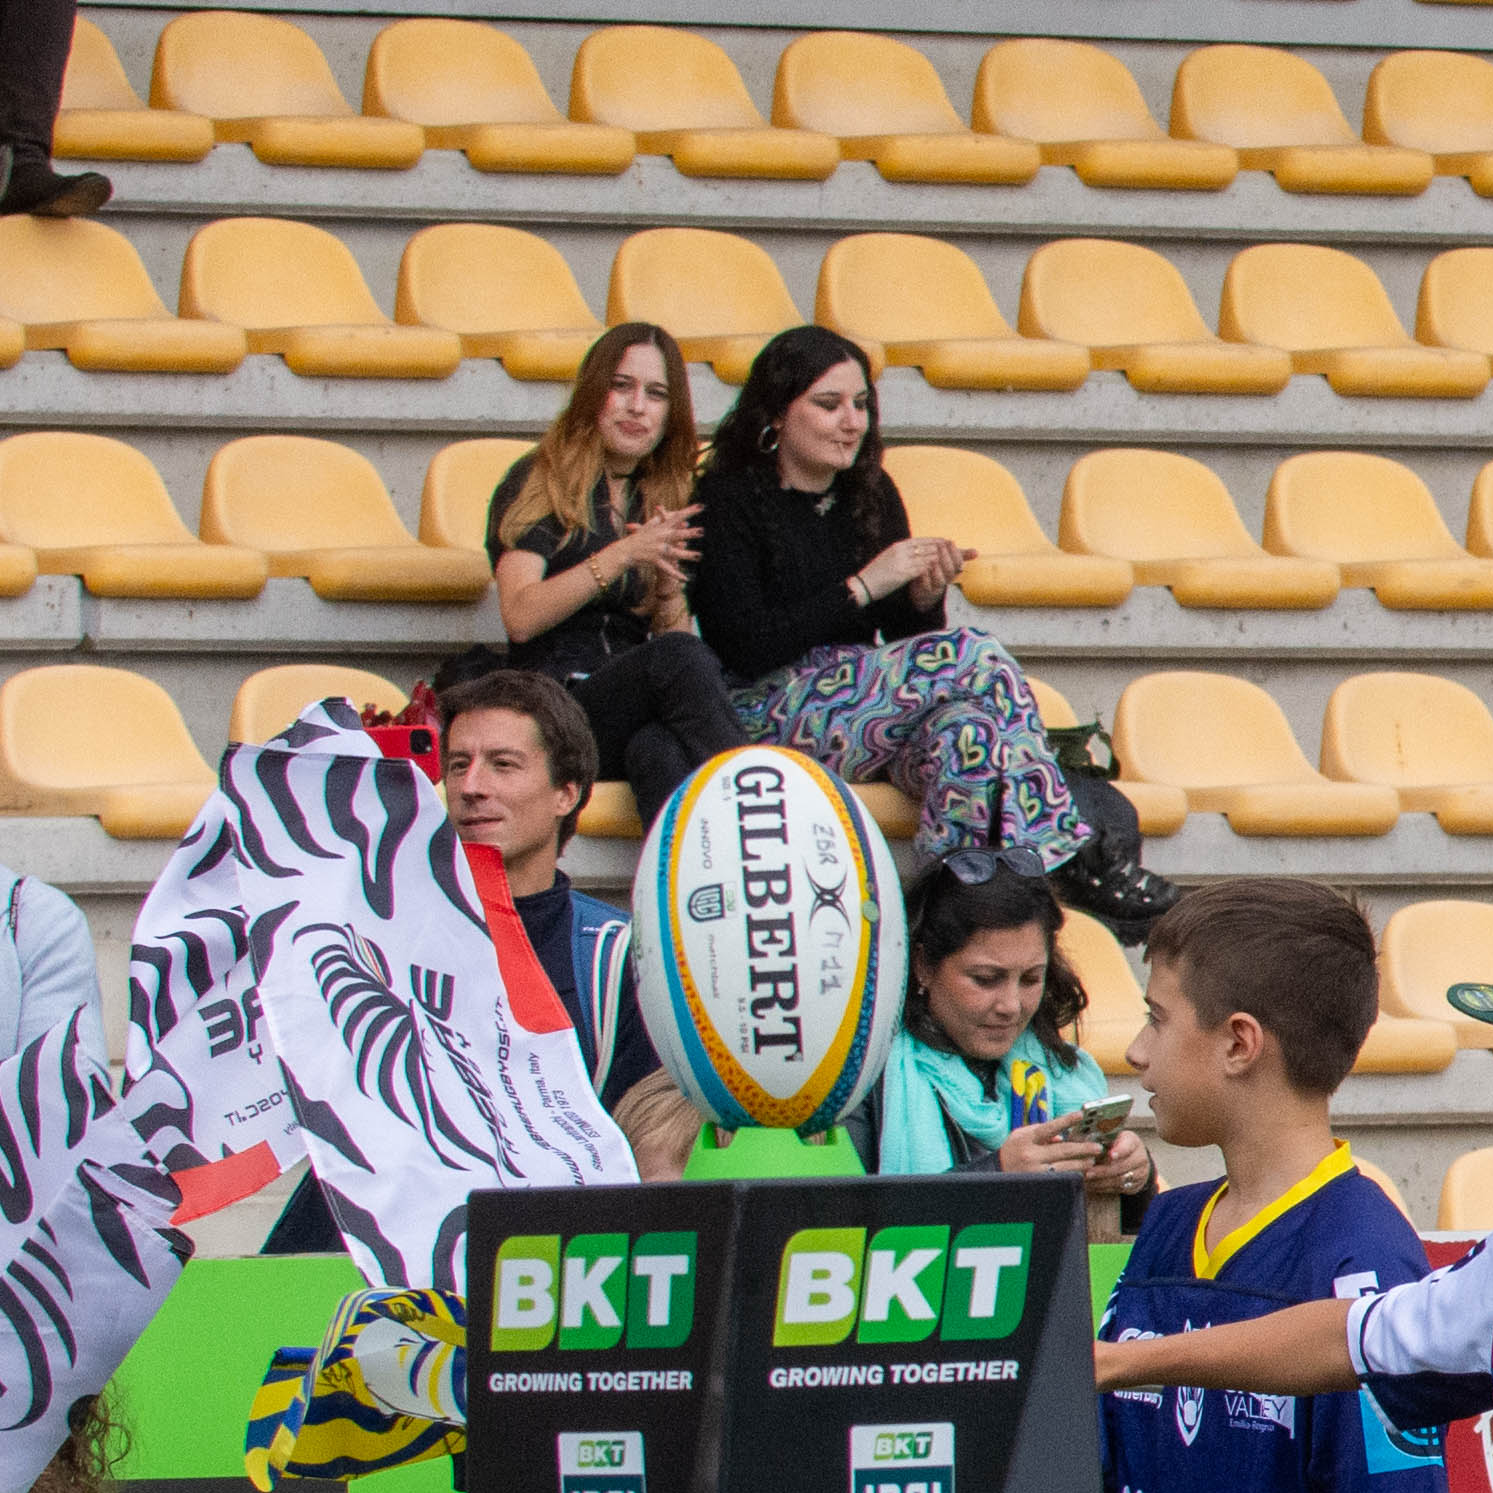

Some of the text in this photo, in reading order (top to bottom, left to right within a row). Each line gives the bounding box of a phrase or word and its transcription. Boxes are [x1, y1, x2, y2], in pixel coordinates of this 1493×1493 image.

[734, 765, 804, 1062] GILBERT
[528, 1052, 542, 1075] Italy
[497, 1252, 691, 1330] BKT
[782, 1245, 1024, 1326] BKT
[489, 1371, 693, 1393] GROWING TOGETHER
[770, 1360, 1020, 1388] GROWING TOGETHER
[578, 1442, 626, 1464] BKT
[875, 1434, 932, 1459] BKT
